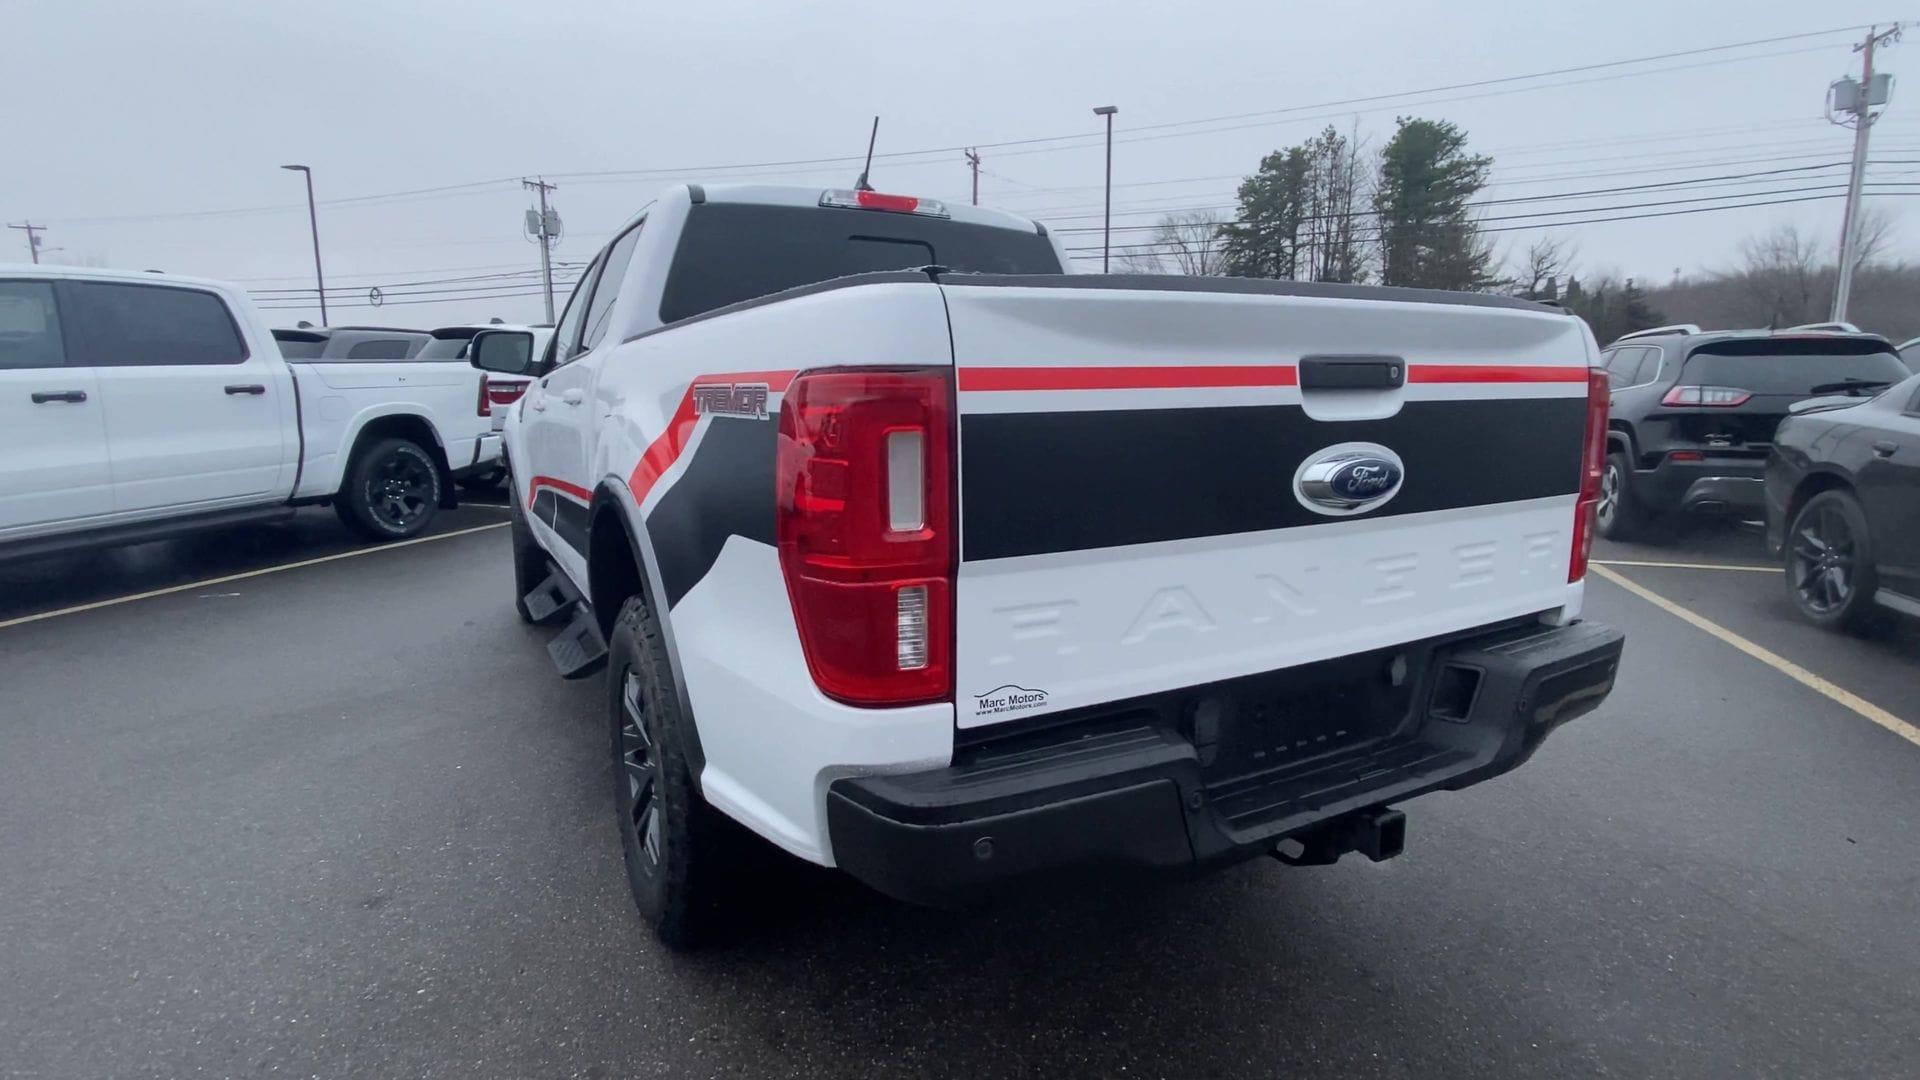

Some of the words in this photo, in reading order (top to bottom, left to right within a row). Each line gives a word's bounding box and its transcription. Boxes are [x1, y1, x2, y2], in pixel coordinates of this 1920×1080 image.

[693, 382, 769, 420] TREMOR
[1347, 465, 1389, 491] Ford
[987, 530, 1561, 666] RANGER
[979, 698, 1006, 709] Marc
[1008, 693, 1045, 705] Motors
